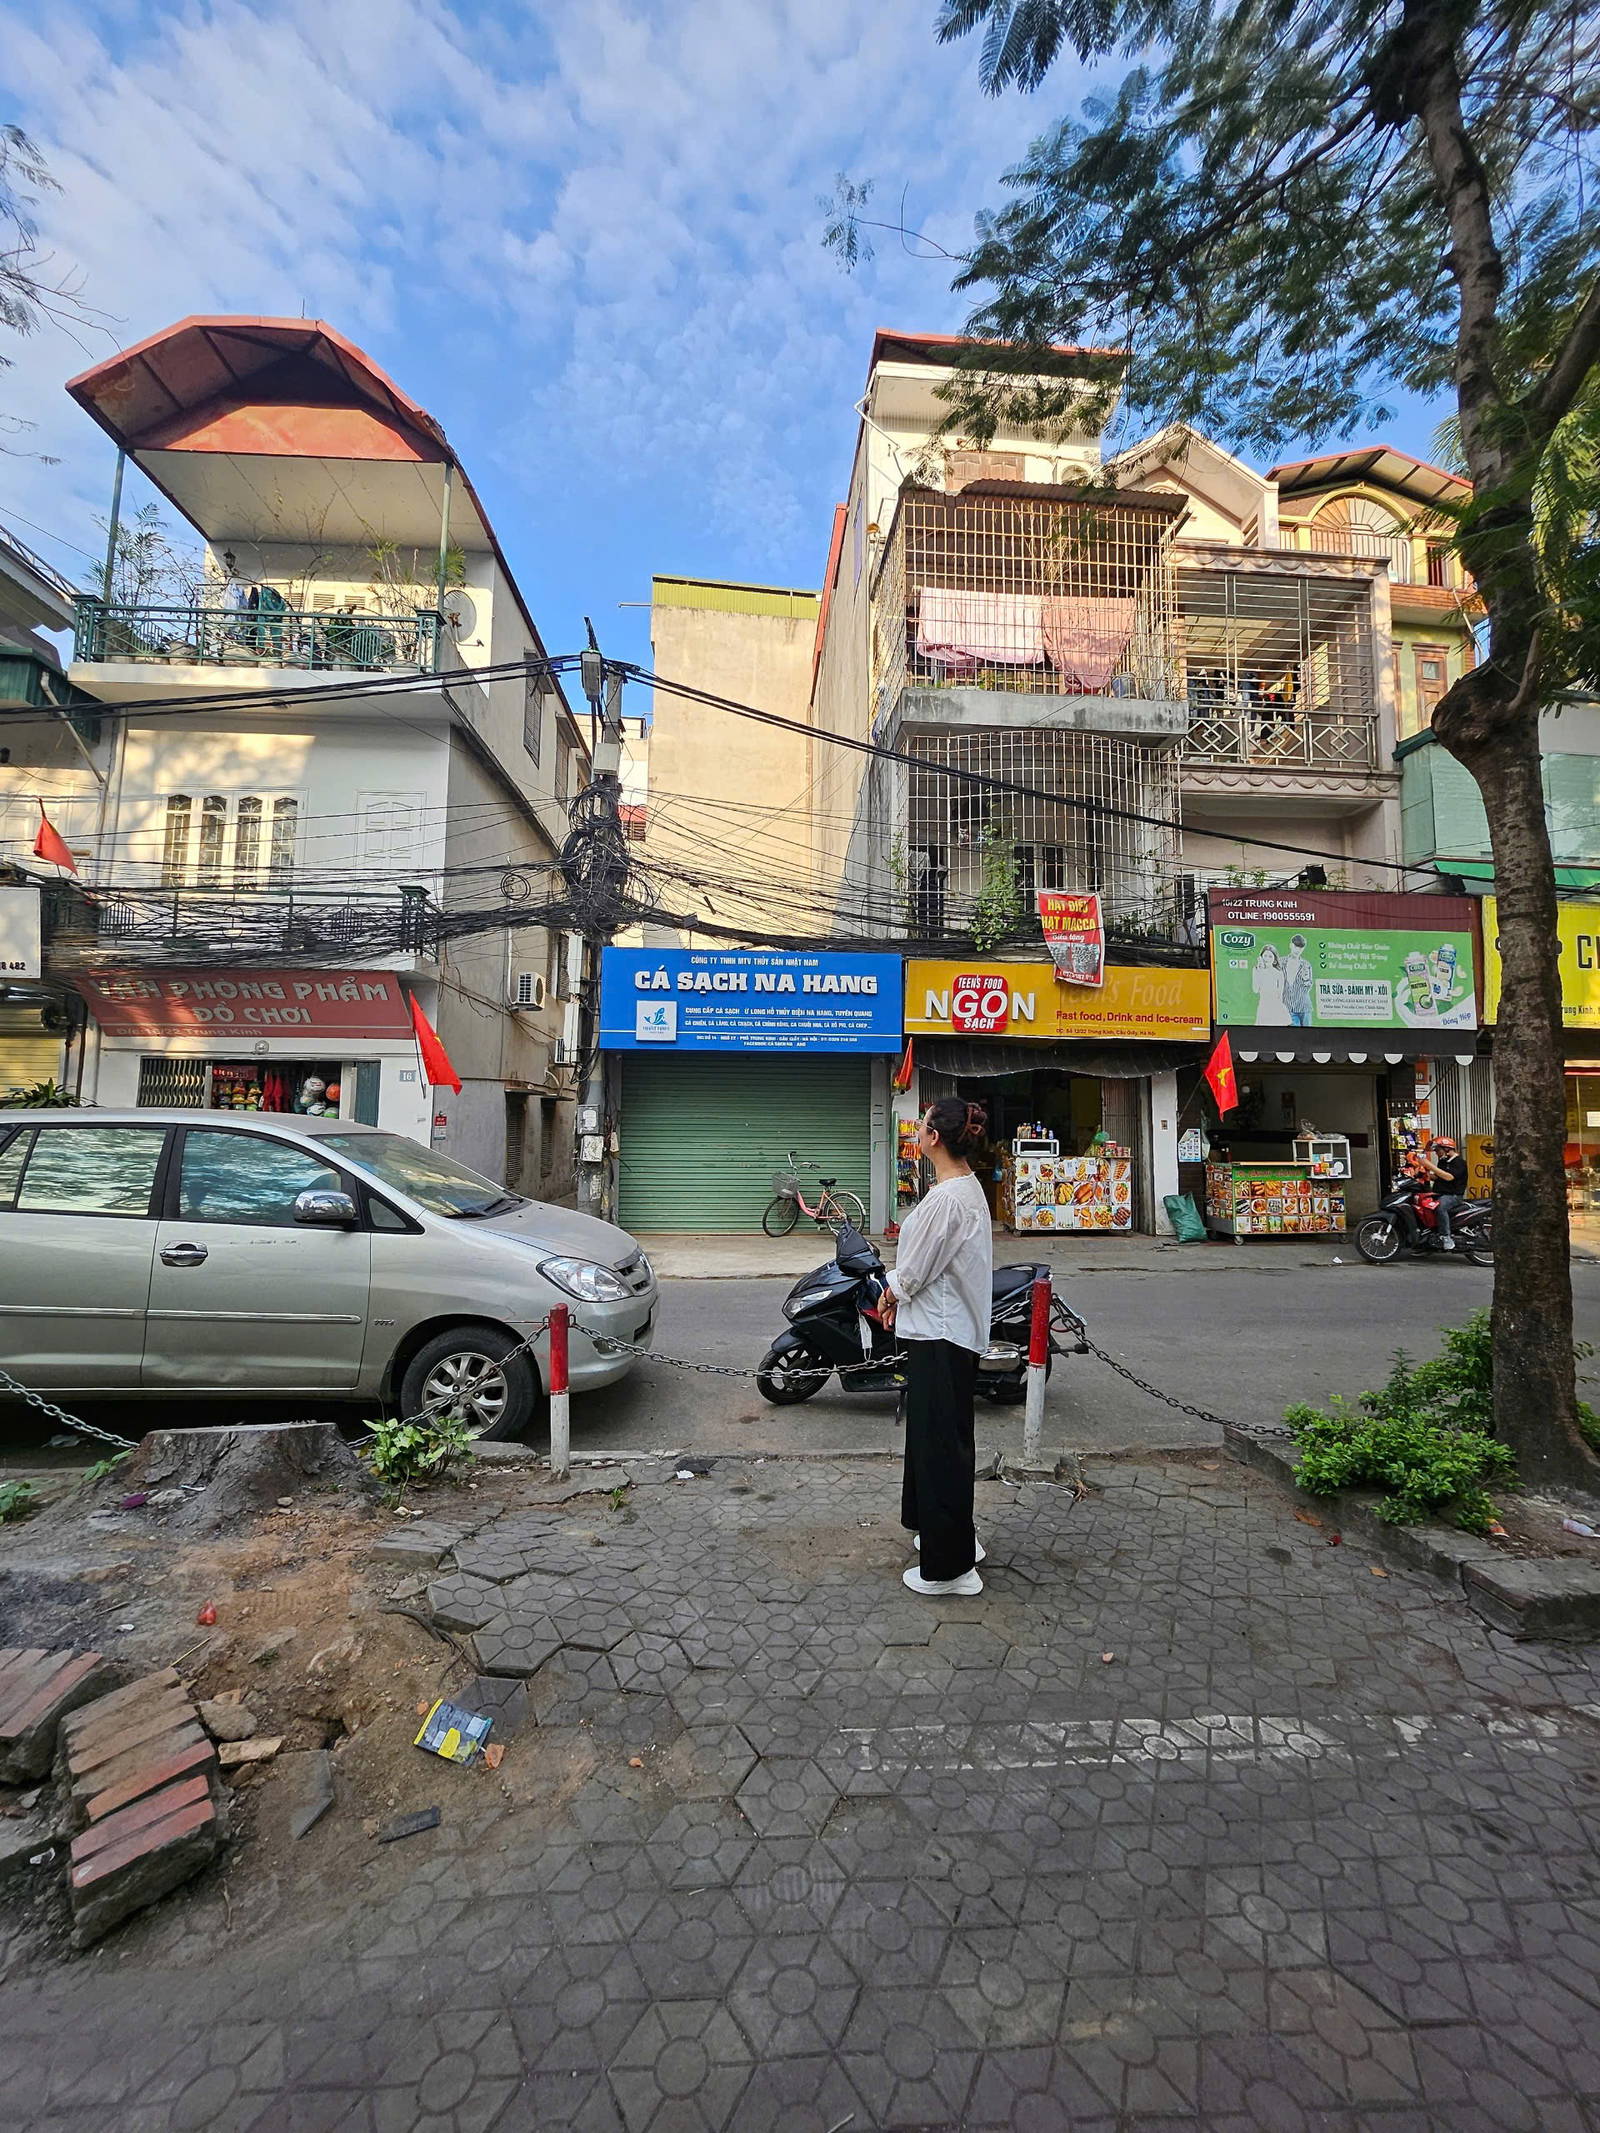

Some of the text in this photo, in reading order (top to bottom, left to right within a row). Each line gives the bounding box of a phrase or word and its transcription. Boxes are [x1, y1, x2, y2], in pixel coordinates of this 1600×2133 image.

[1047, 899, 1066, 914] HẠT
[1244, 900, 1274, 908] TRUNG
[1041, 915, 1096, 932] HẠT MACCA
[1223, 934, 1252, 946] Cozy
[9, 962, 26, 970] 482
[738, 957, 751, 965] MTV
[803, 959, 818, 967] NAM
[634, 965, 878, 994] CÁ SẠCH NA HANG
[983, 978, 1003, 990] FOOD
[168, 978, 286, 999] PHÒNG
[293, 976, 389, 1001] PHẨM
[925, 990, 1035, 1021] NGON
[192, 1001, 312, 1024] ĐỒ CHƠI
[1056, 1011, 1077, 1020] Fast
[1107, 1012, 1133, 1022] Drink
[1135, 1013, 1153, 1022] and
[1156, 1014, 1203, 1024] Ice-cream
[963, 1018, 995, 1030] SẠCH
[402, 1072, 412, 1080] 16
